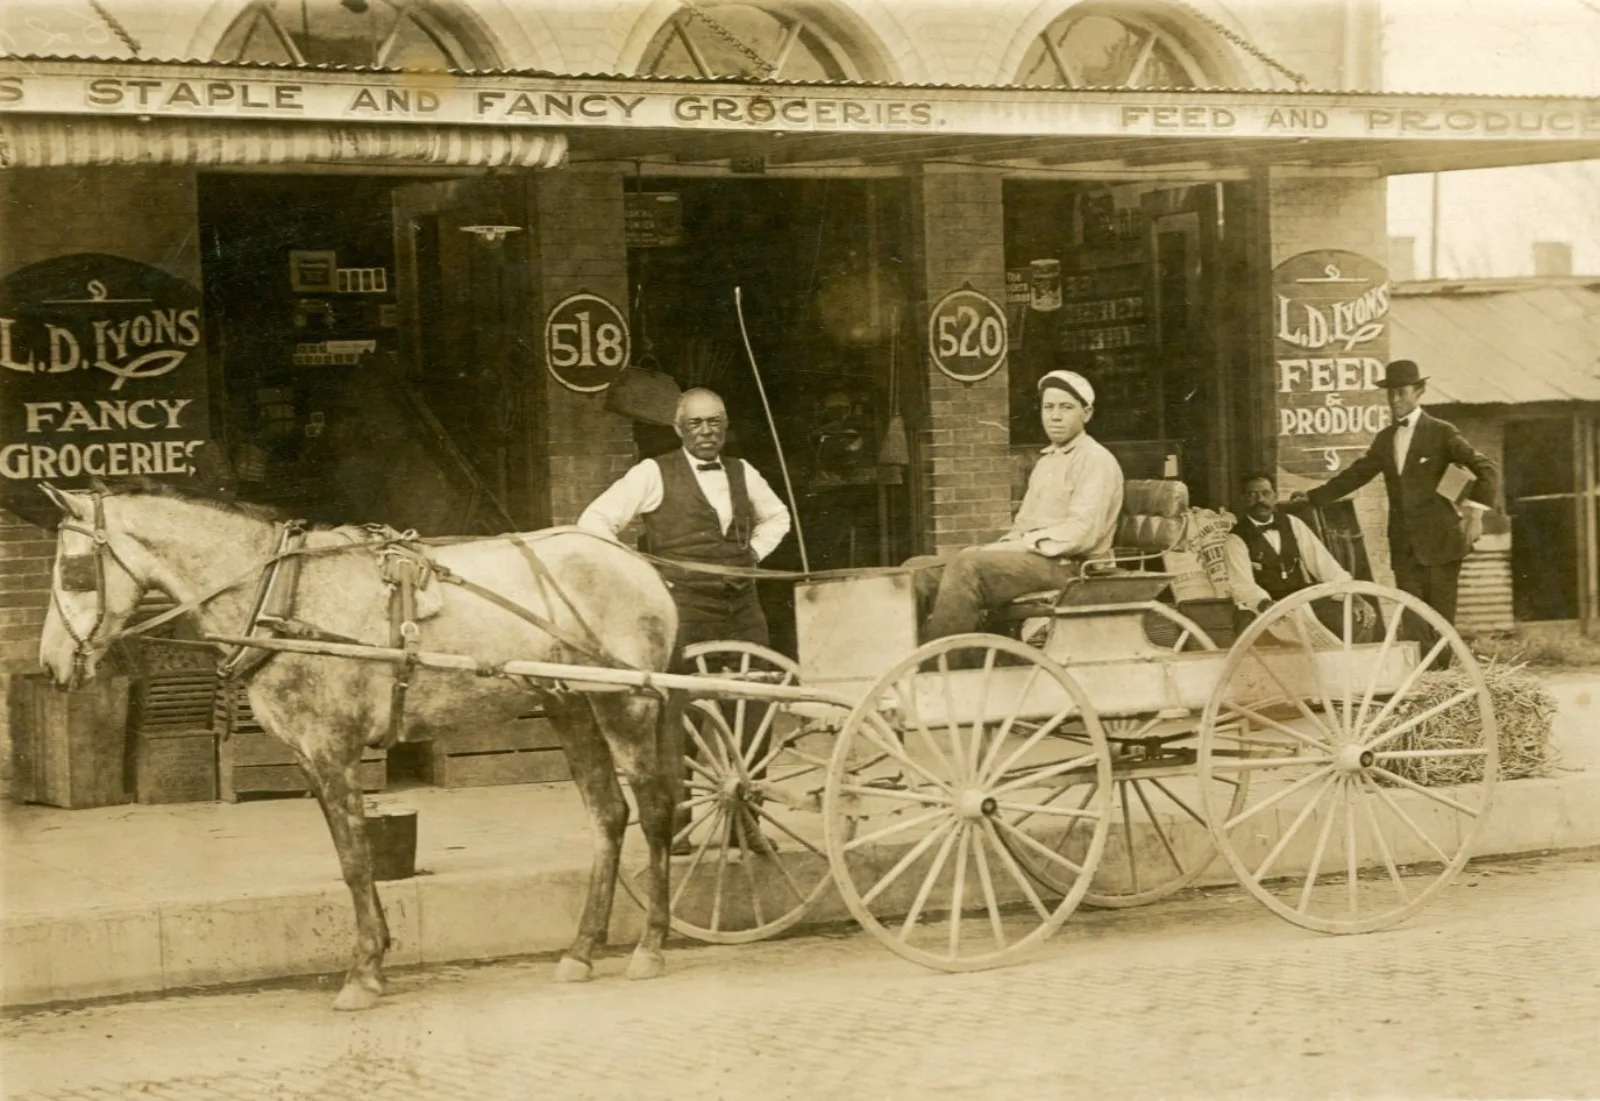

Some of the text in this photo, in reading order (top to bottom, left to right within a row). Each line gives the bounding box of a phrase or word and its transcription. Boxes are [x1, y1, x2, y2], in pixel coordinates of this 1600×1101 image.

[88, 79, 304, 110] STAPLE
[350, 88, 440, 113] AND
[478, 92, 646, 119] FANCY
[674, 96, 947, 126] GROCERIES.
[1121, 106, 1236, 130] FEED
[1267, 108, 1328, 130] AND
[1366, 108, 1600, 133] PRODUCE
[551, 311, 623, 367] 518
[938, 305, 1002, 358] 520
[24, 399, 193, 432] FANCY
[1325, 393, 1344, 406] &
